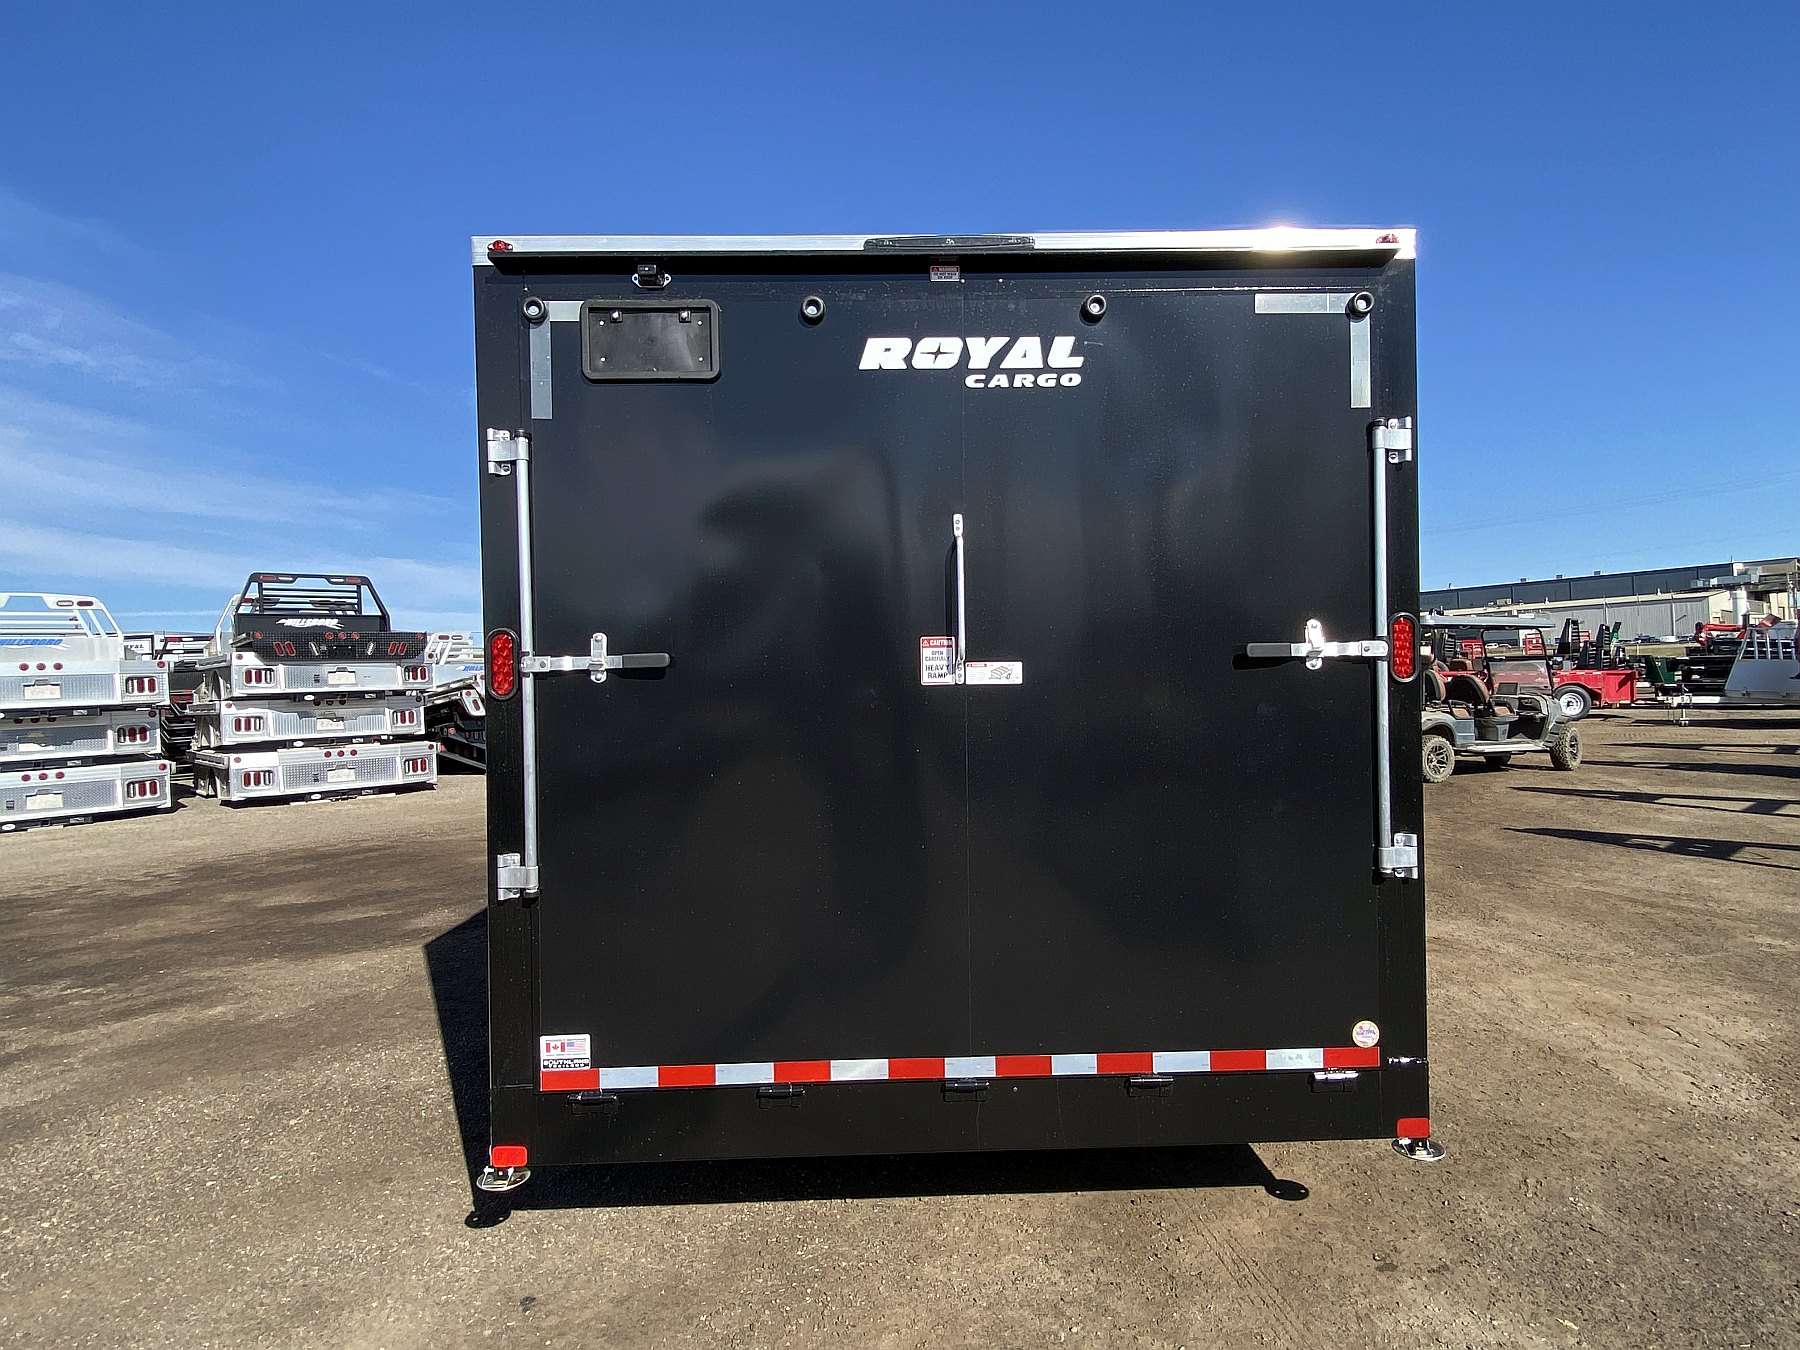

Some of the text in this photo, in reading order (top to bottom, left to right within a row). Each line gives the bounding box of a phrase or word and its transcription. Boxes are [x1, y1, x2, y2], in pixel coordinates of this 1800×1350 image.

[858, 336, 1084, 370] ROYAL
[964, 373, 1082, 388] CARGO
[925, 664, 950, 672] HEAVY
